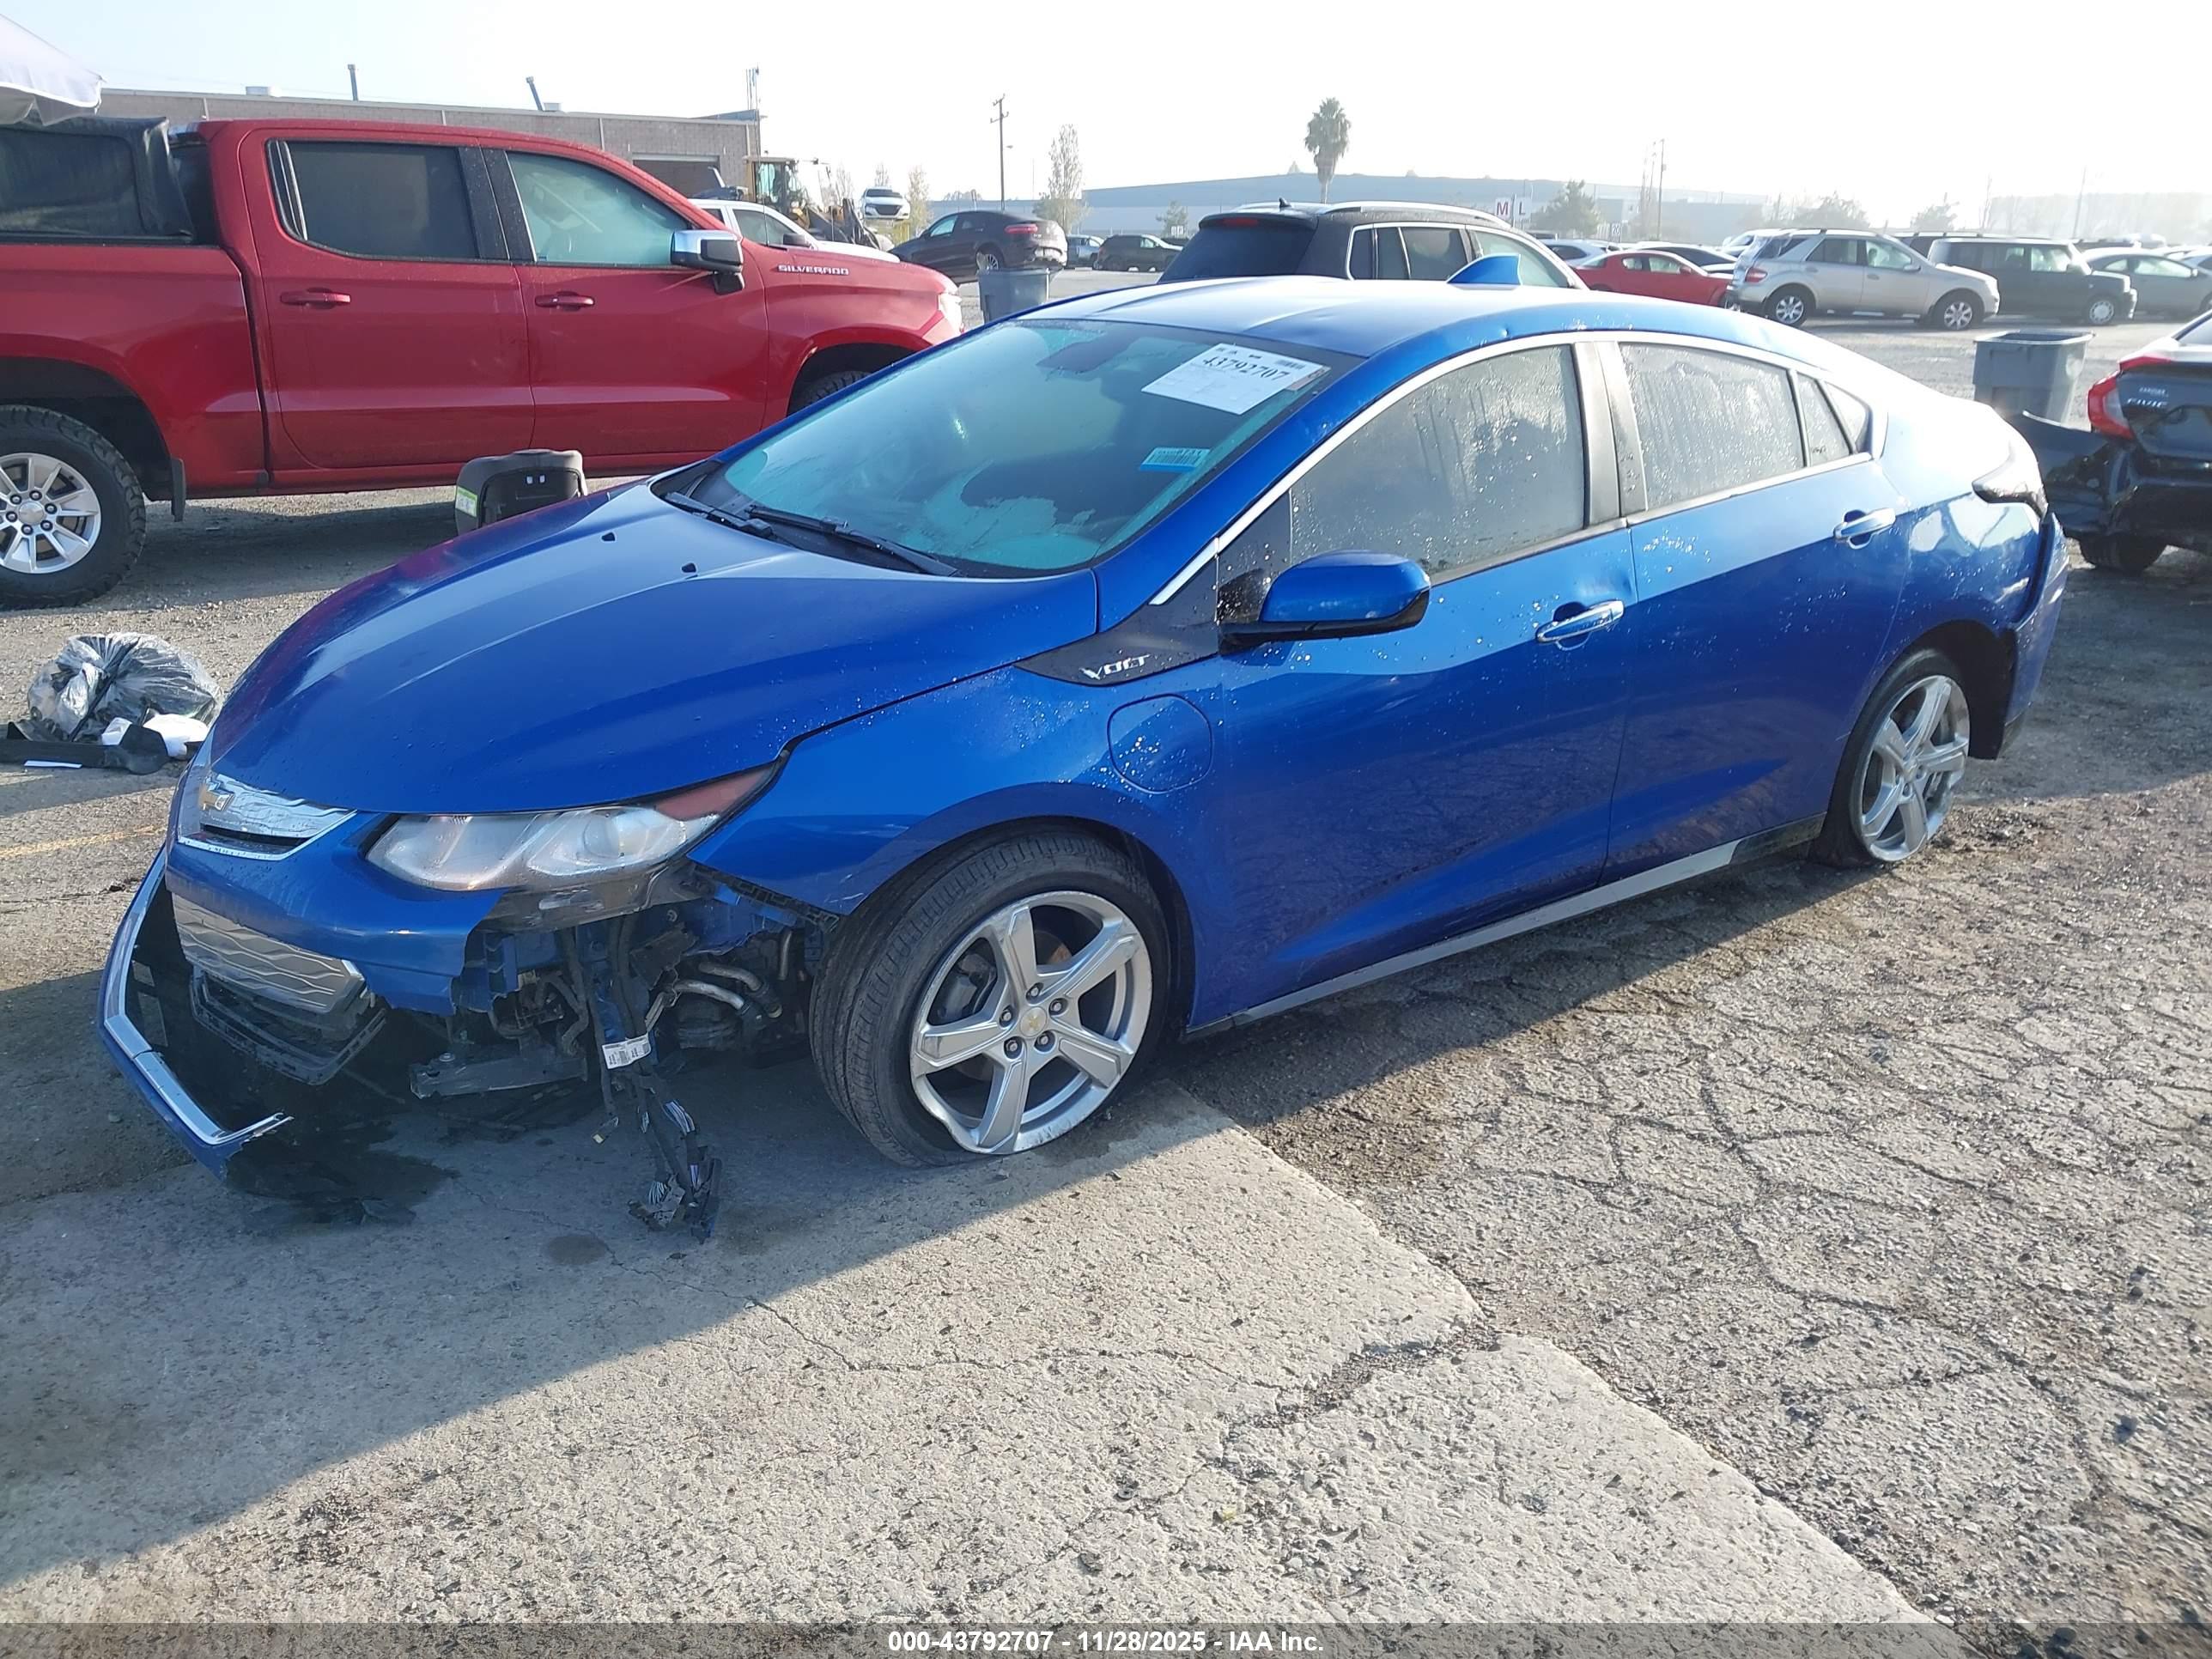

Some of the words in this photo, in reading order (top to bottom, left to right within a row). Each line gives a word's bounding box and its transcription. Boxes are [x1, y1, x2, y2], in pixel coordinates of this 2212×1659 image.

[1497, 202, 1509, 216] M
[1519, 202, 1526, 215] L
[777, 264, 849, 275] SILVERADO
[1202, 356, 1291, 381] 43792707
[1079, 654, 1151, 680] VOLT
